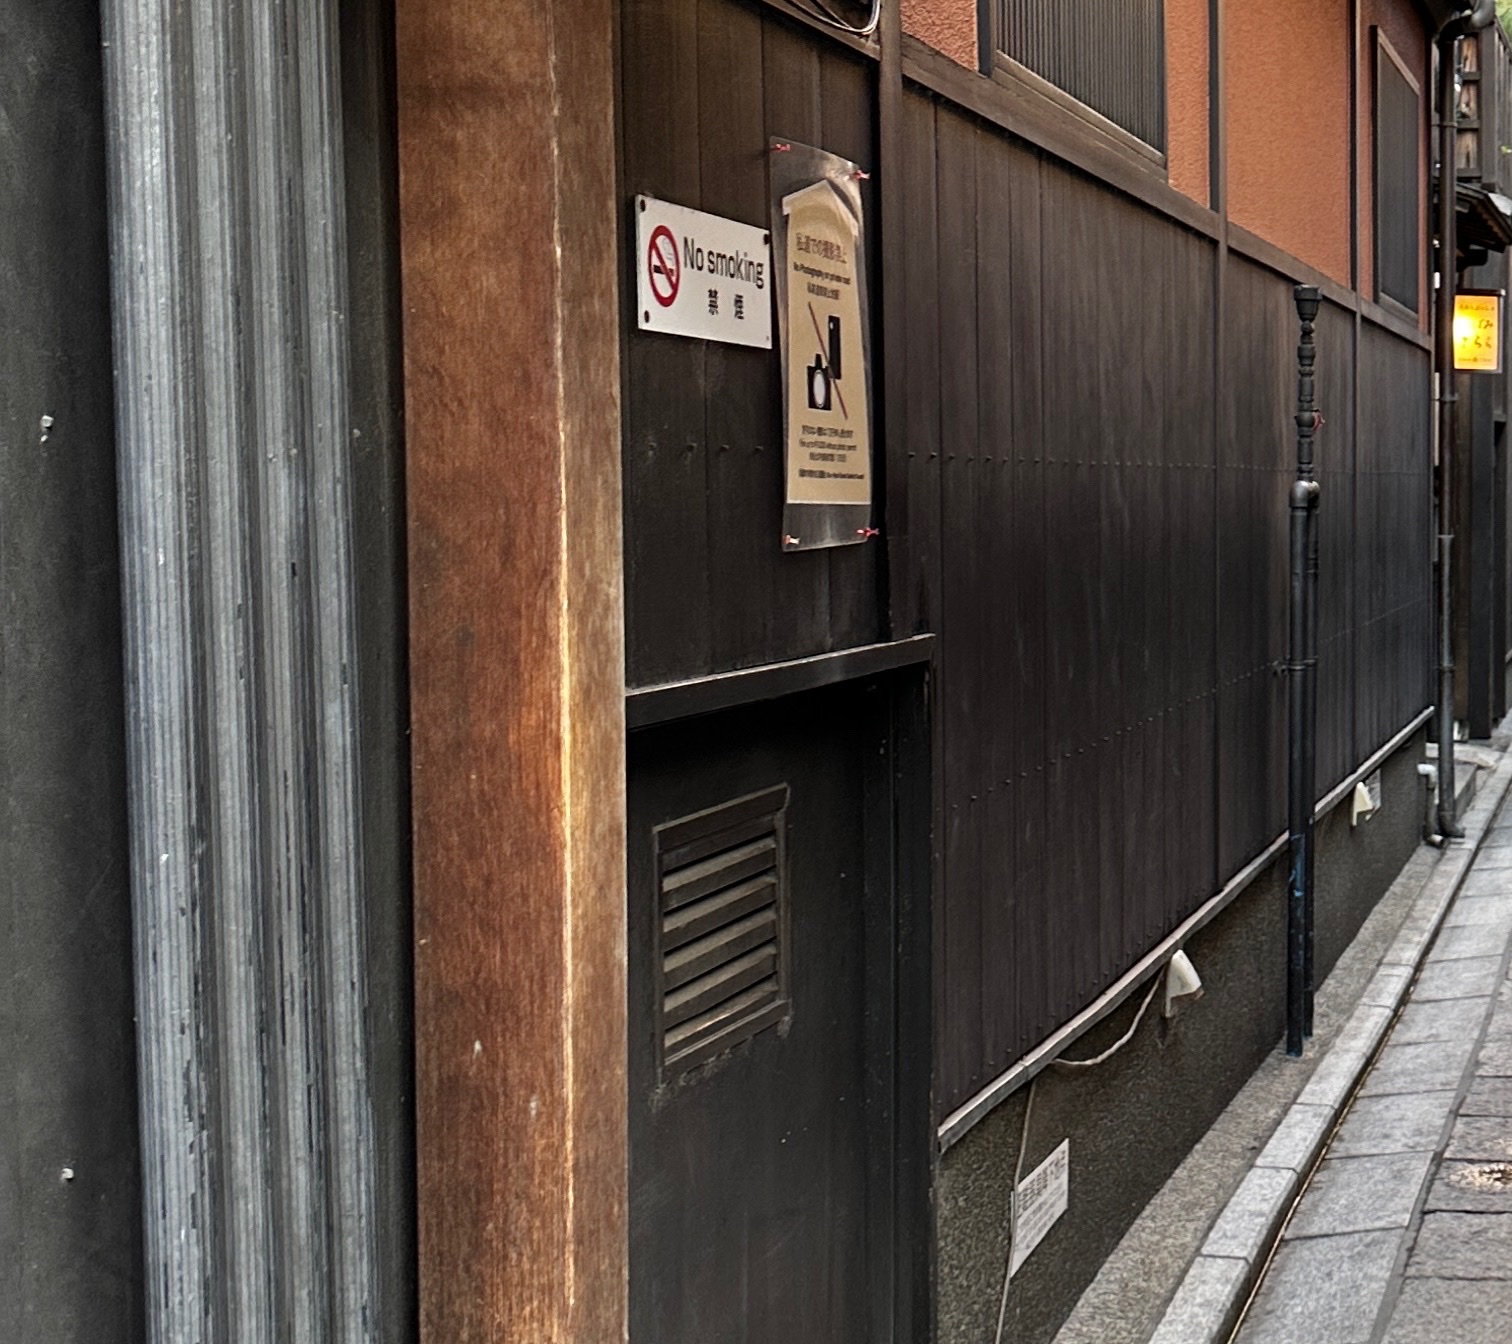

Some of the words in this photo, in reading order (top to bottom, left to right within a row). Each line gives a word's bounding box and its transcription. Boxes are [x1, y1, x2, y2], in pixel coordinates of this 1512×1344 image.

[683, 236, 704, 272] No
[707, 249, 764, 290] smoking
[708, 288, 745, 320] 禁煙
